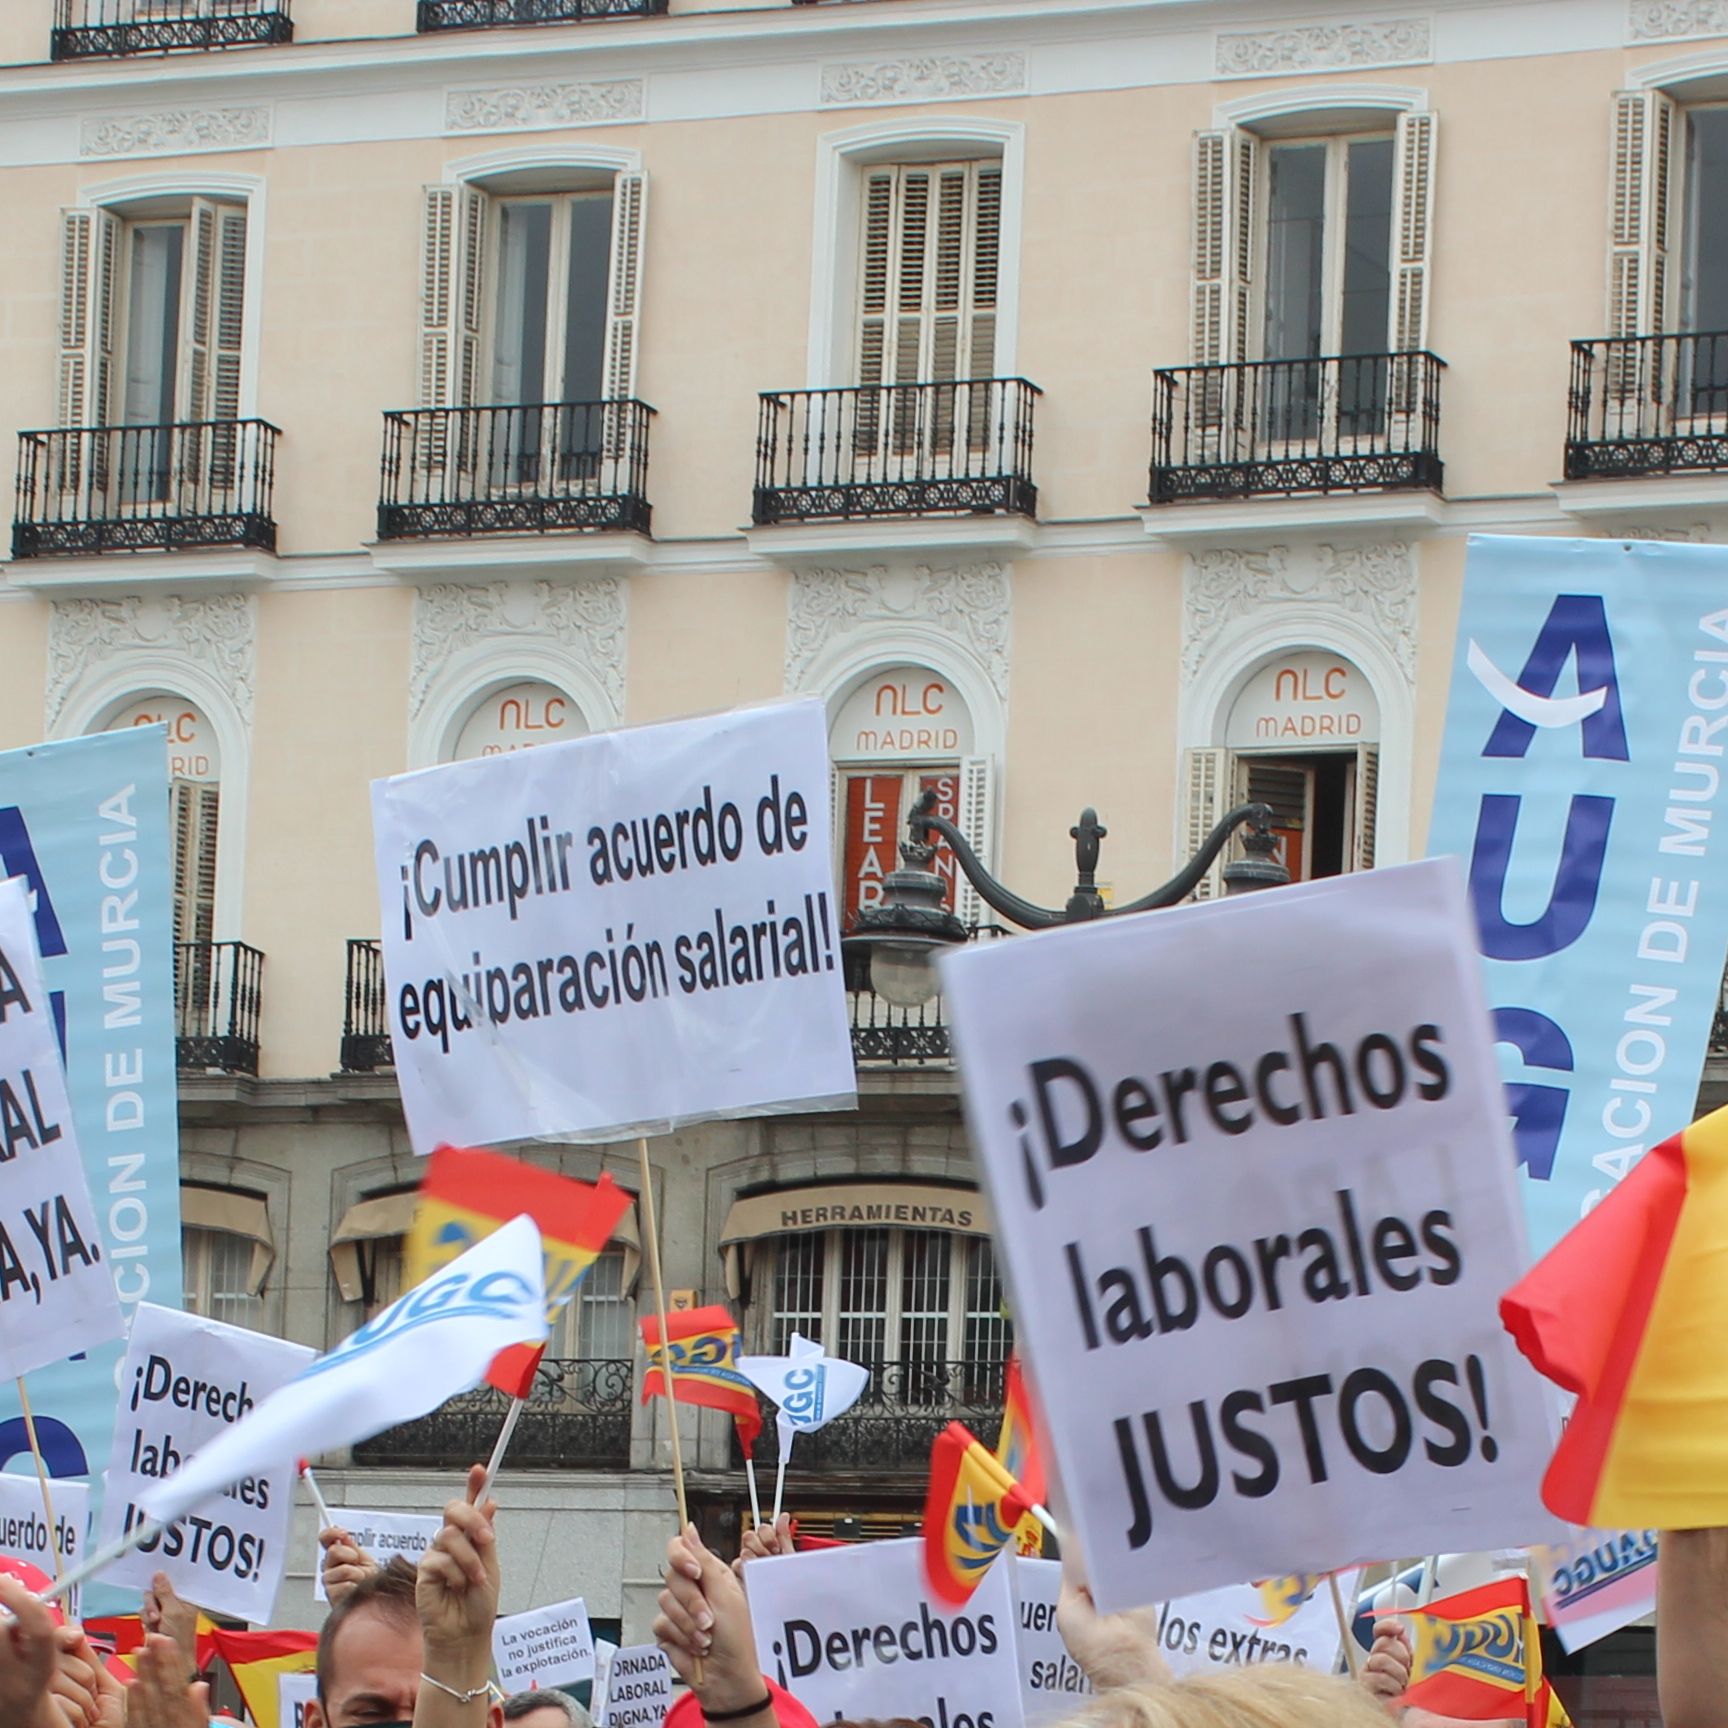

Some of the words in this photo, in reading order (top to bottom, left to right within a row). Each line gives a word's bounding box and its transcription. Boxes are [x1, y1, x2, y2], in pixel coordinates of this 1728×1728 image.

[400, 814, 574, 941] ¡Cumplir
[587, 785, 744, 886] acuerdo
[756, 773, 808, 854] de
[99, 783, 141, 1029] MURCIA
[1639, 881, 1699, 965] DE
[398, 922, 670, 1056] equiparación
[674, 891, 836, 995] salarial!
[105, 1047, 143, 1132] DE
[1008, 1012, 1453, 1211] ¡Derechos
[780, 1202, 973, 1233] HERRAMIENTAS
[1064, 1188, 1463, 1352] laborales
[130, 1353, 255, 1424] ¡Derech
[1112, 1352, 1499, 1550] JUSTOS!
[55, 1514, 76, 1556] de
[378, 1530, 427, 1552] acuerdo
[500, 1633, 519, 1647] La
[519, 1616, 578, 1642] vocación
[501, 1666, 513, 1679] la
[515, 1646, 592, 1675] explotación.
[508, 1648, 525, 1662] no
[526, 1634, 578, 1659] justifica
[613, 1653, 666, 1678] ORNADA
[771, 1601, 999, 1692] ¡Derechos
[1157, 1600, 1201, 1655] los
